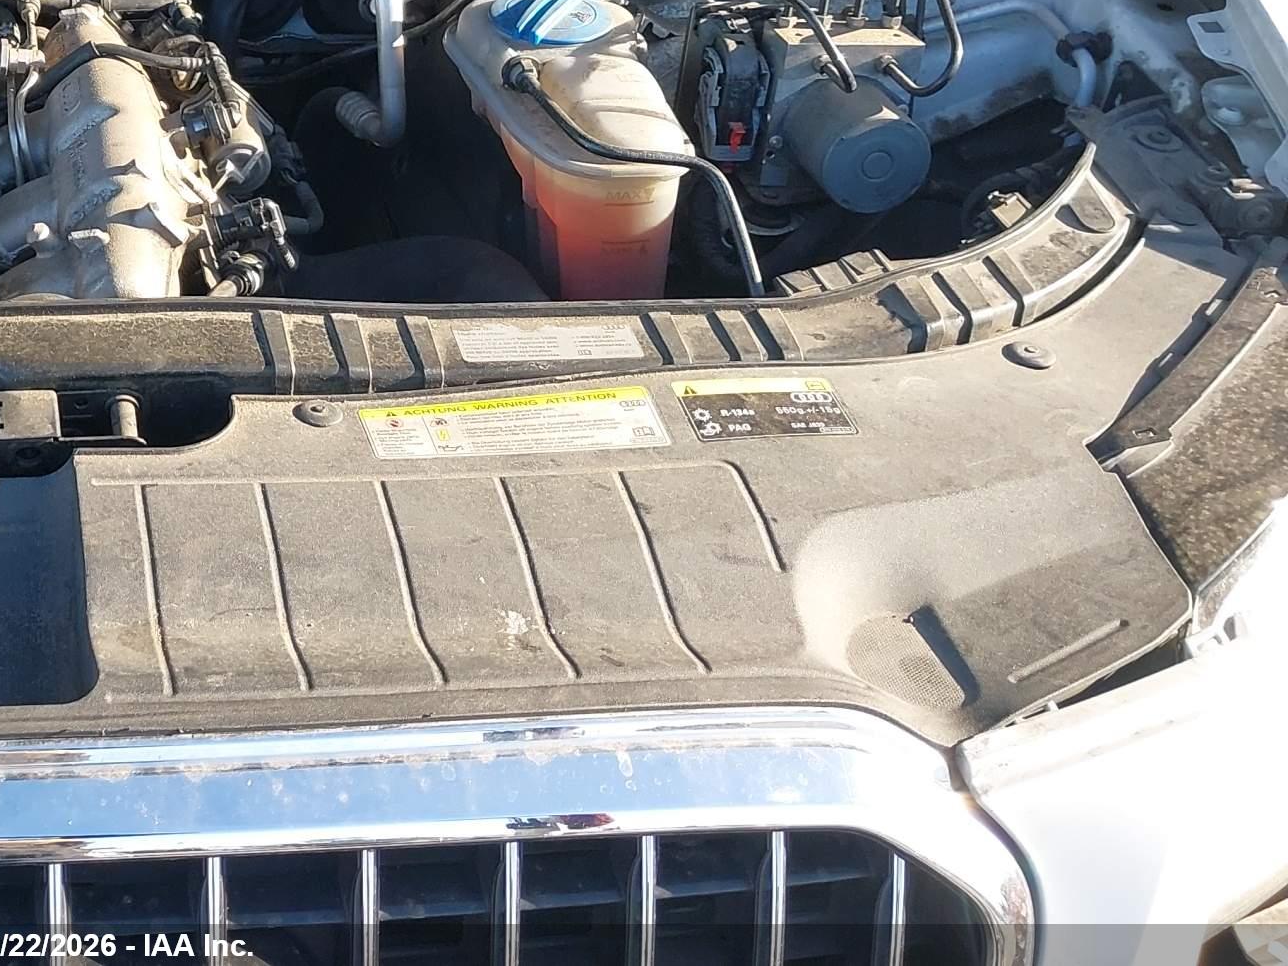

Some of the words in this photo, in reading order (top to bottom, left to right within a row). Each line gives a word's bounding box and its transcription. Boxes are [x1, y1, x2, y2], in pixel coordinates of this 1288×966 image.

[606, 188, 642, 202] MAX
[403, 405, 467, 416] ACHTUNG
[474, 399, 539, 410] WARNING
[545, 392, 617, 405] ATTENTION
[720, 408, 755, 417] R-134a
[728, 423, 752, 432] PAG
